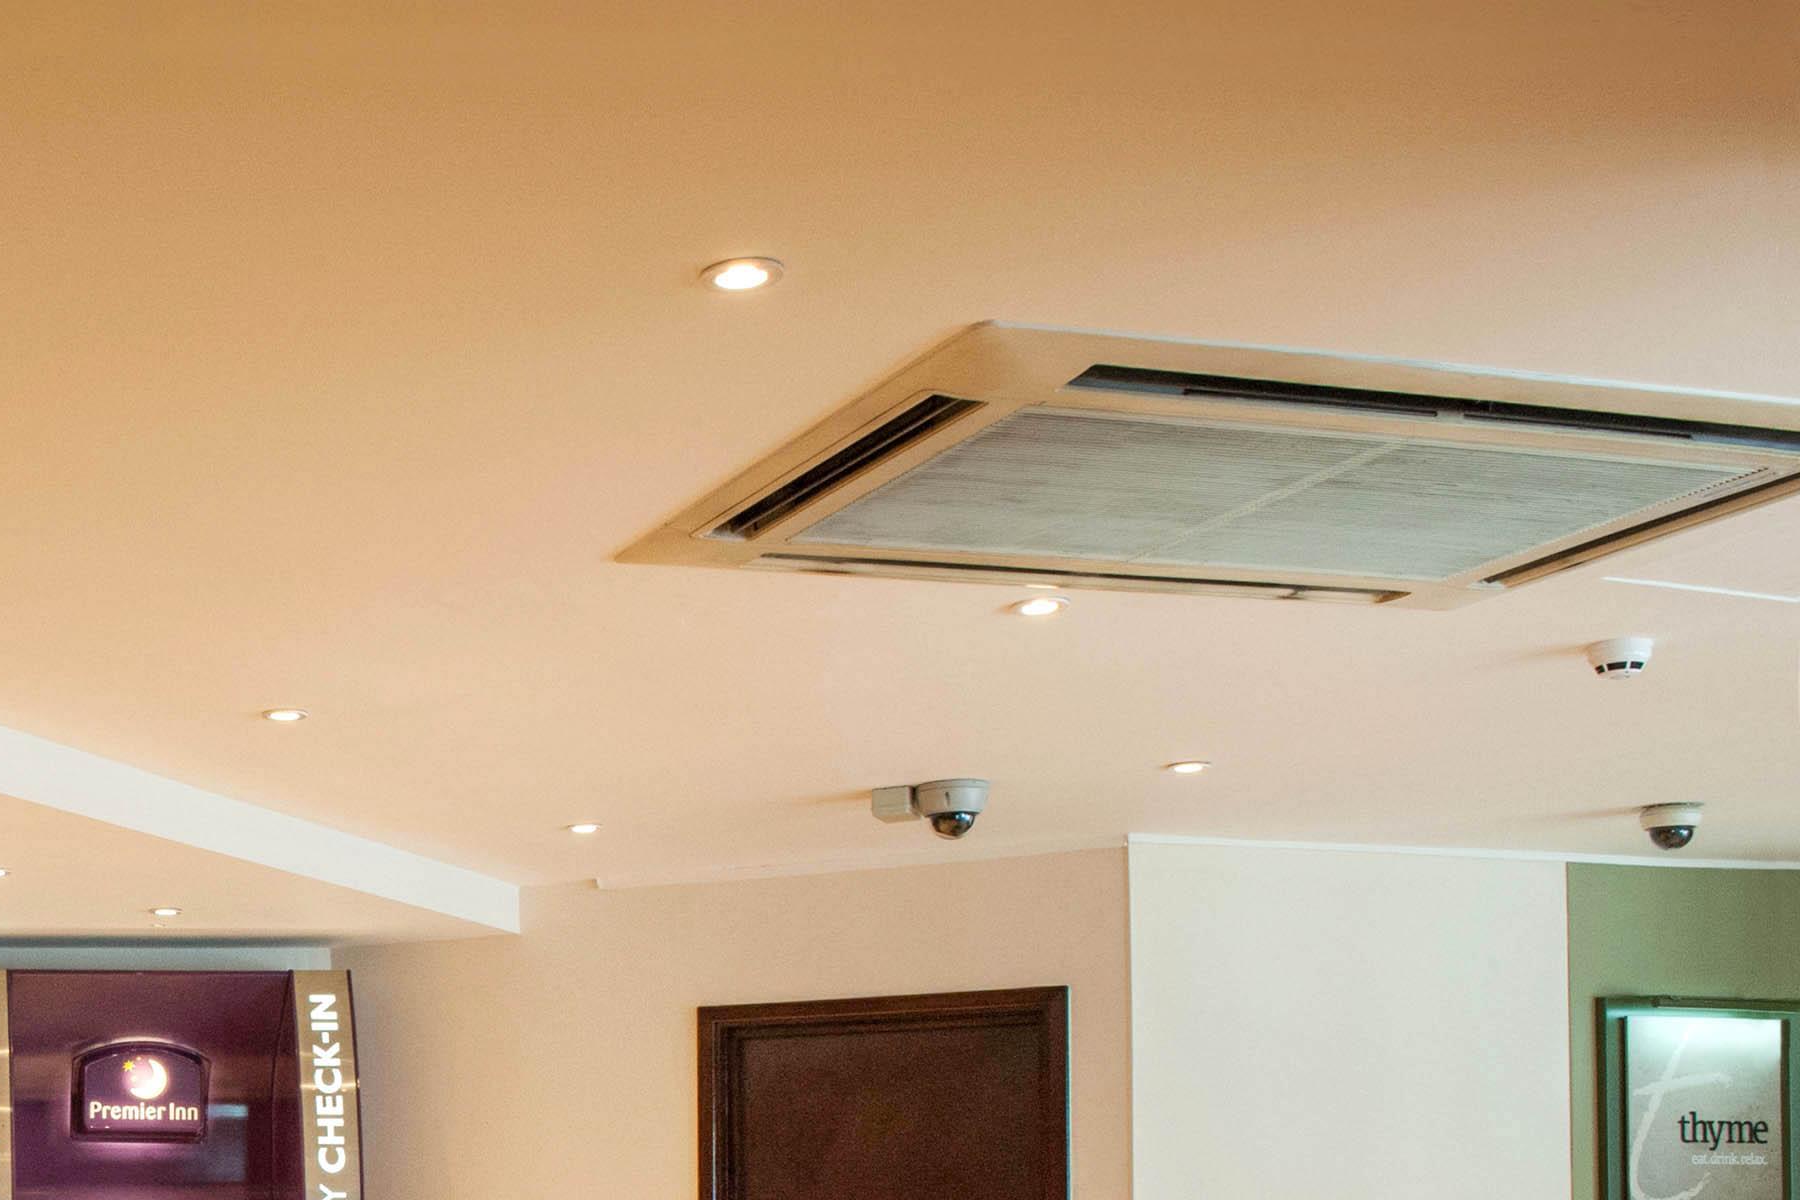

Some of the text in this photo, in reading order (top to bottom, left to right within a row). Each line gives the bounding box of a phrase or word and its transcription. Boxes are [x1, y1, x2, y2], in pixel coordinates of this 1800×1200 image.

[309, 994, 346, 1174] CHECK-IN
[89, 1100, 199, 1121] Premier Inn
[1677, 1111, 1769, 1151] thyme
